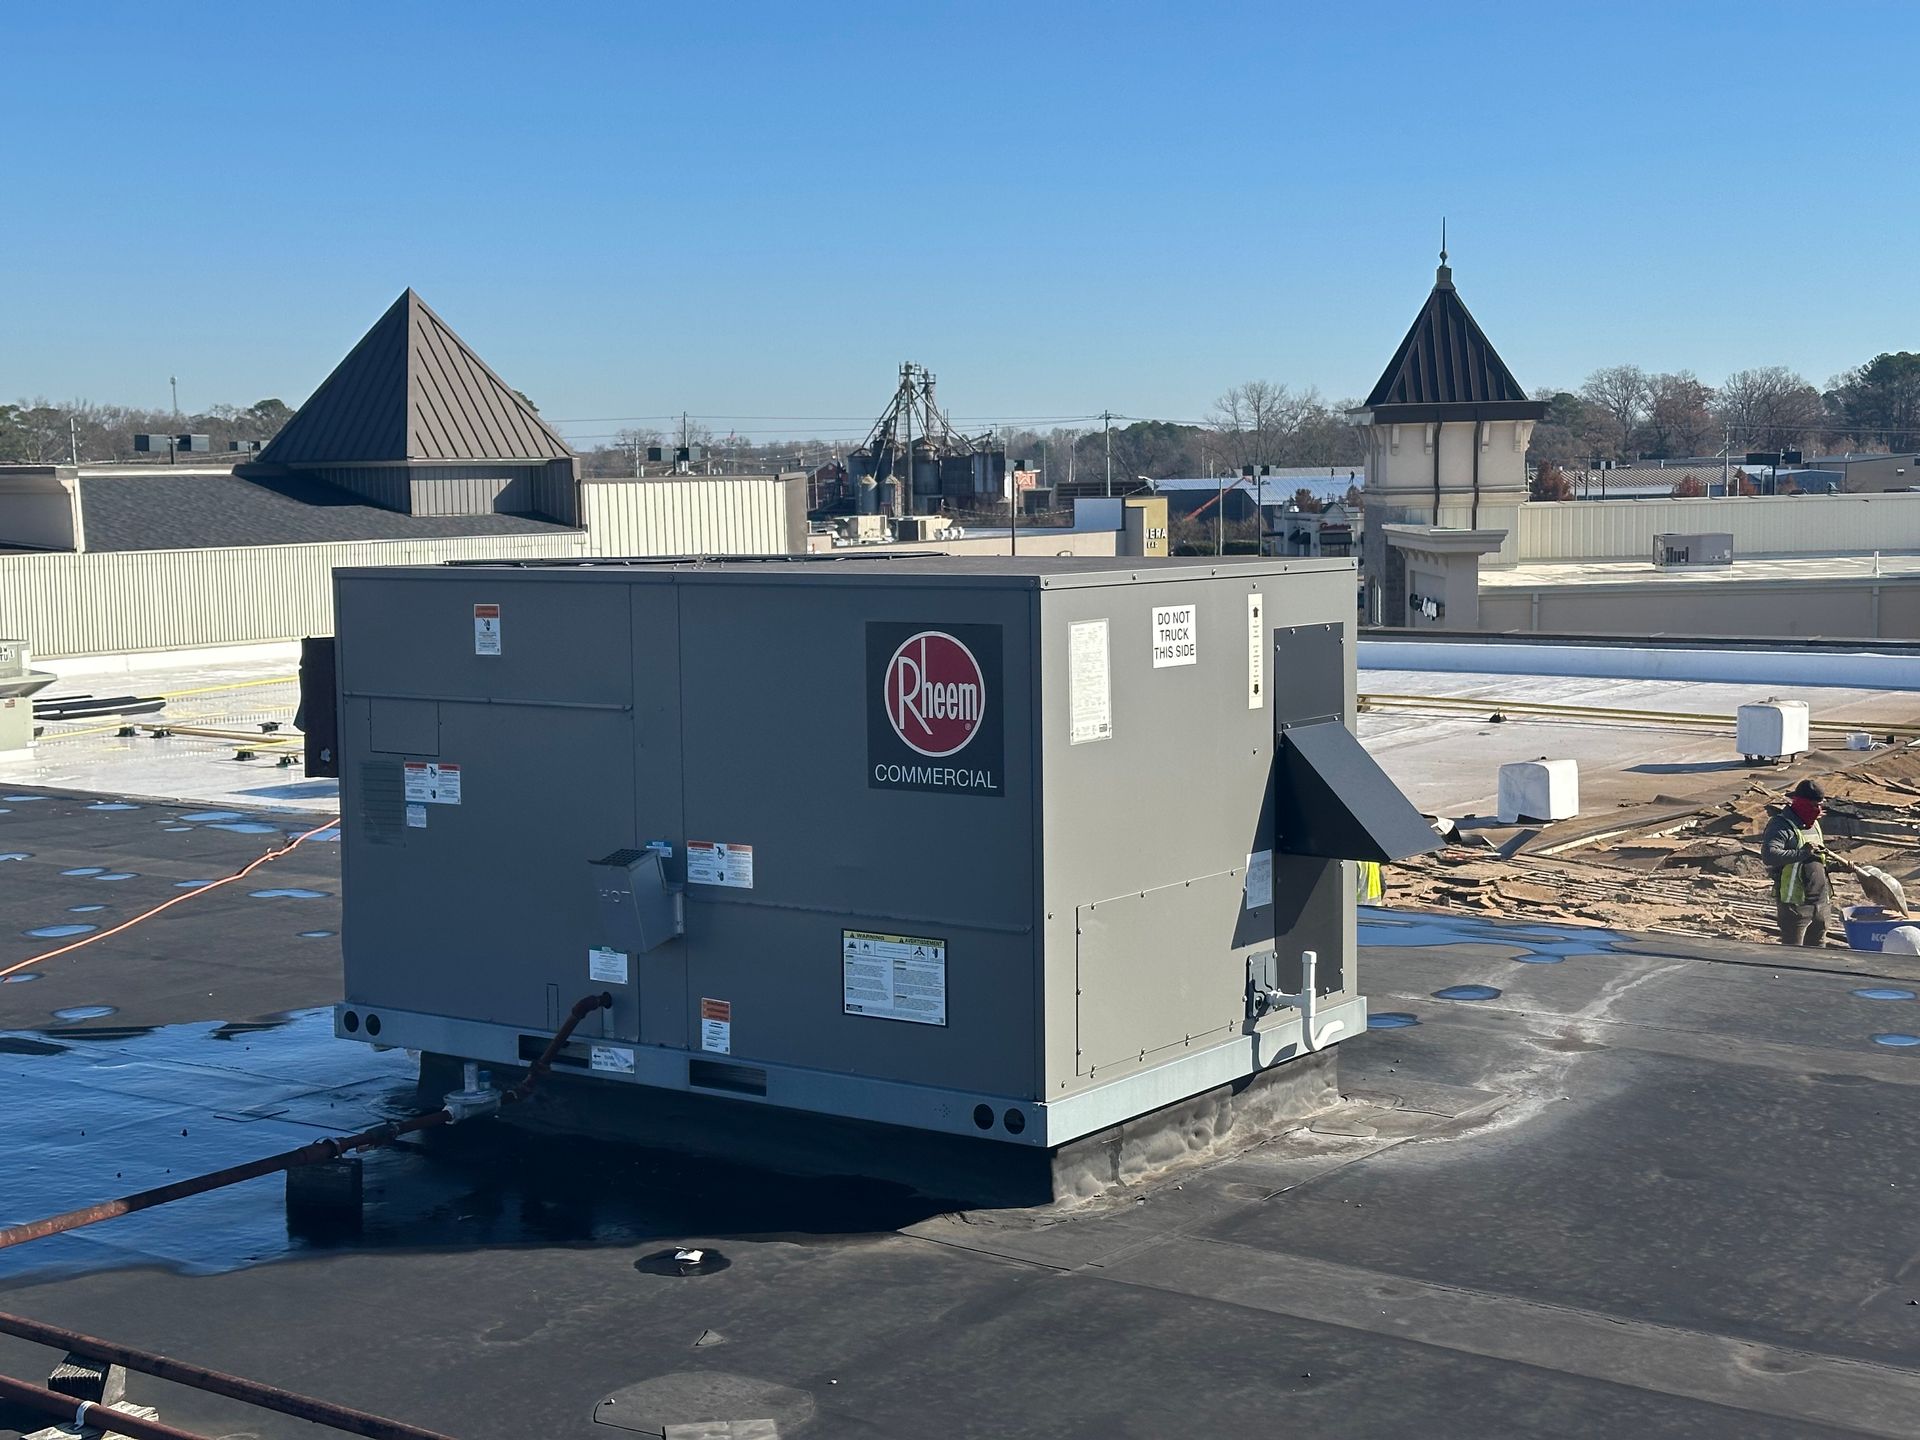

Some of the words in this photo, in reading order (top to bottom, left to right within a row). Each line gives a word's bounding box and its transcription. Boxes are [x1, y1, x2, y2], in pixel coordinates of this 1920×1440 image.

[1157, 612, 1170, 625] DO
[1173, 611, 1190, 624] NOT
[1160, 628, 1189, 642] TRUCK
[1154, 645, 1173, 660] THIS
[1176, 643, 1194, 657] SIDE
[898, 637, 977, 735] Rheem
[874, 763, 998, 789] COMMERCIAL
[857, 933, 885, 941] WARNING
